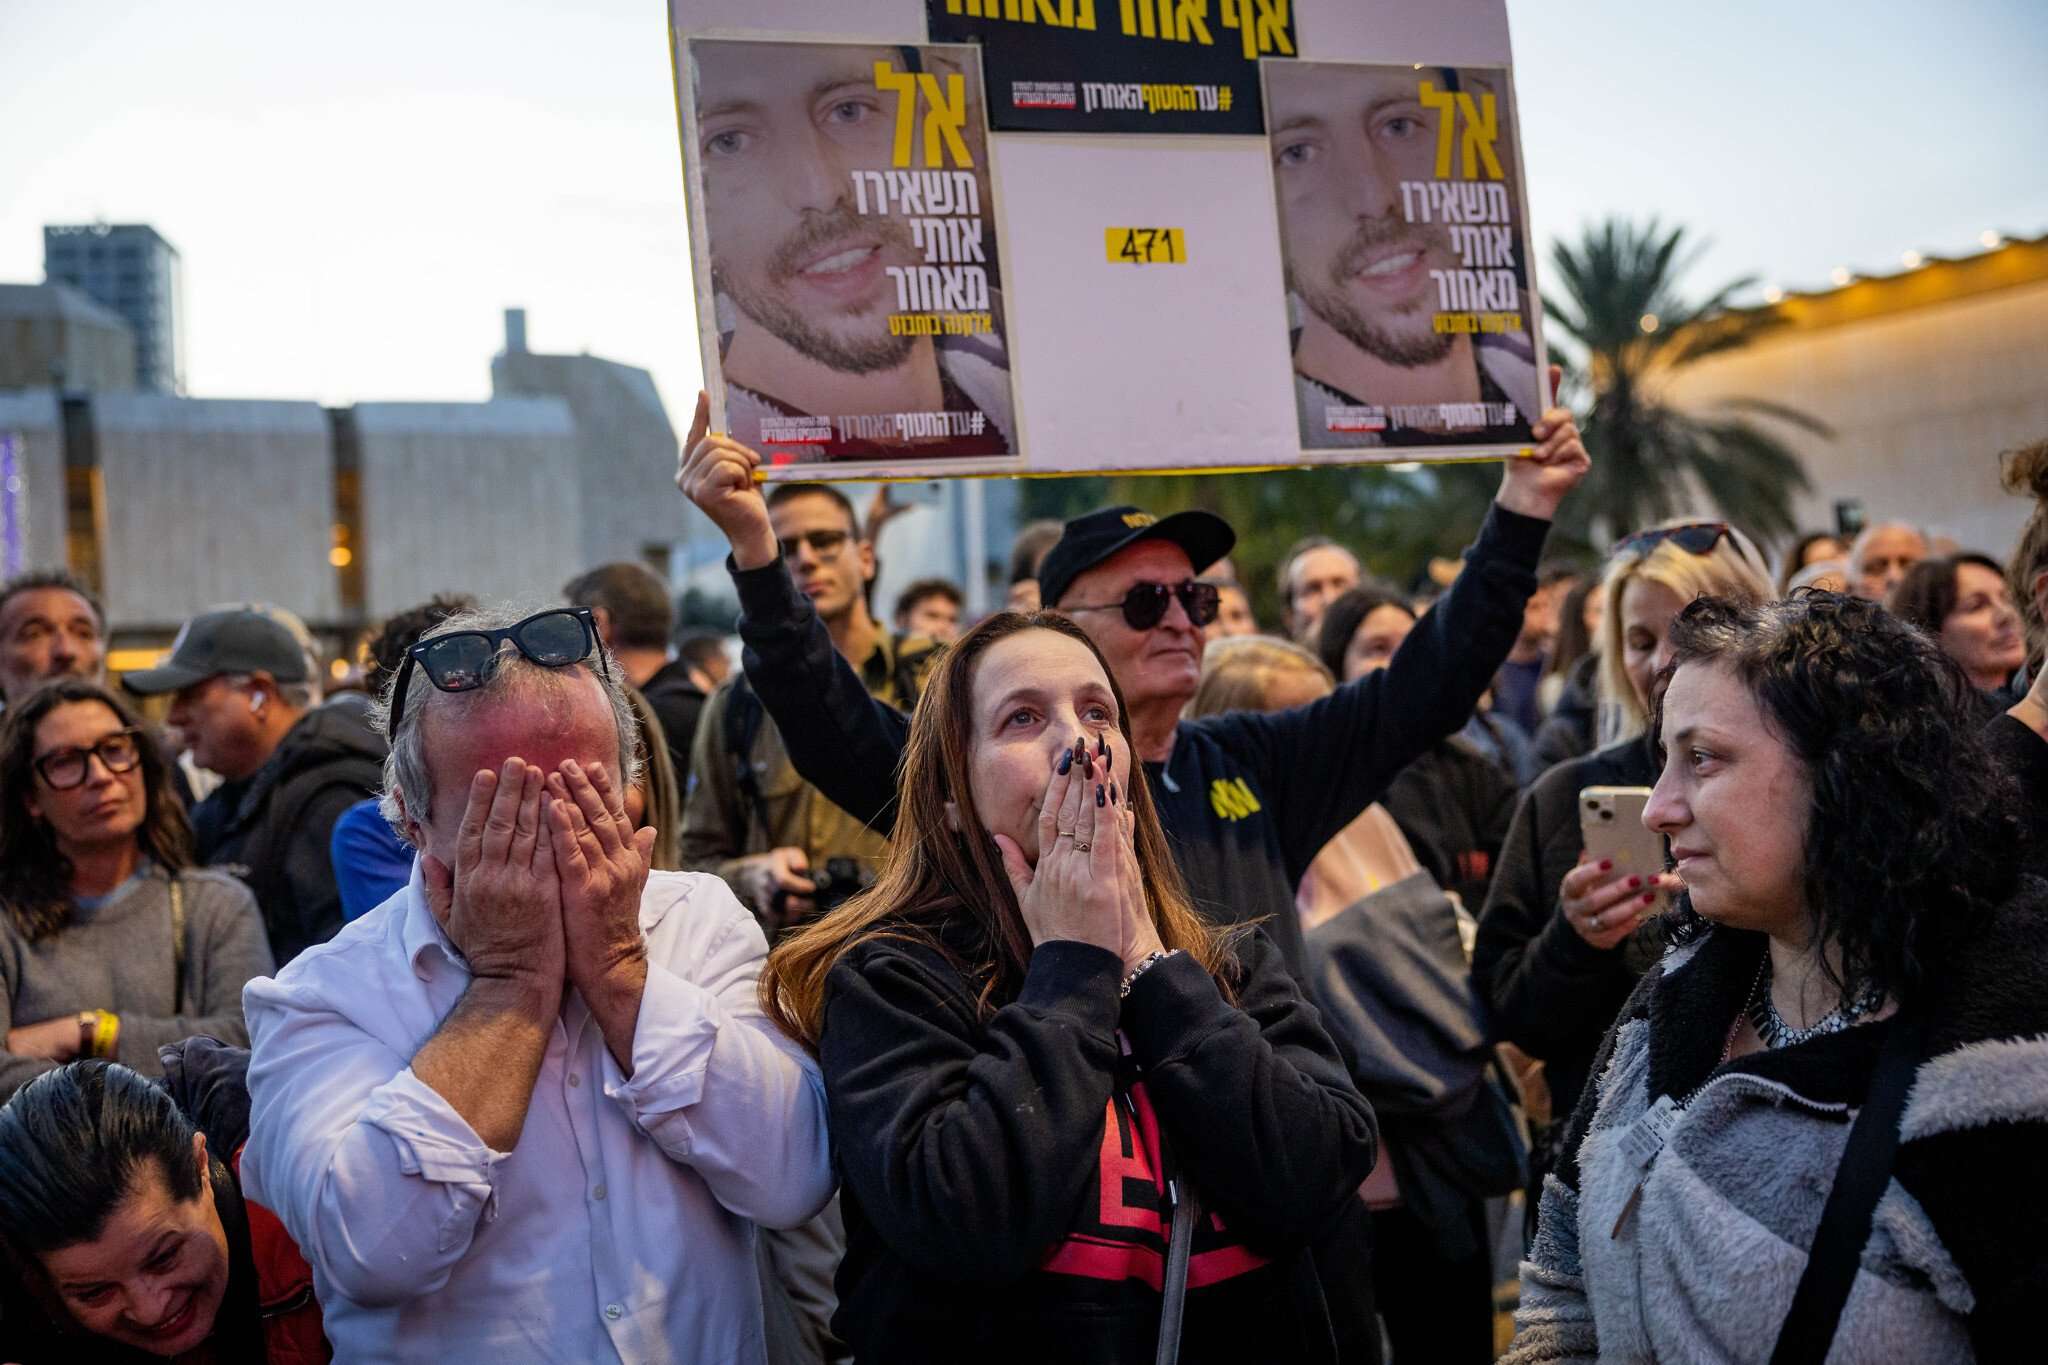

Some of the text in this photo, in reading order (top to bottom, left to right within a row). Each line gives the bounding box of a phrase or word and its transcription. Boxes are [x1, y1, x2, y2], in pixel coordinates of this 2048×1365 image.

[1220, 0, 1295, 60] אף
[874, 61, 975, 168] אל
[1081, 83, 1233, 113] #עדהחטוףהאחרון
[1418, 80, 1505, 179] אל
[851, 171, 980, 215] תשאירו
[1400, 181, 1510, 223] תשאירו
[910, 218, 986, 262] אותי
[1120, 228, 1174, 265] 471
[1449, 226, 1515, 268] אותי
[886, 266, 989, 311] מאחור
[1429, 270, 1519, 311] מאחור
